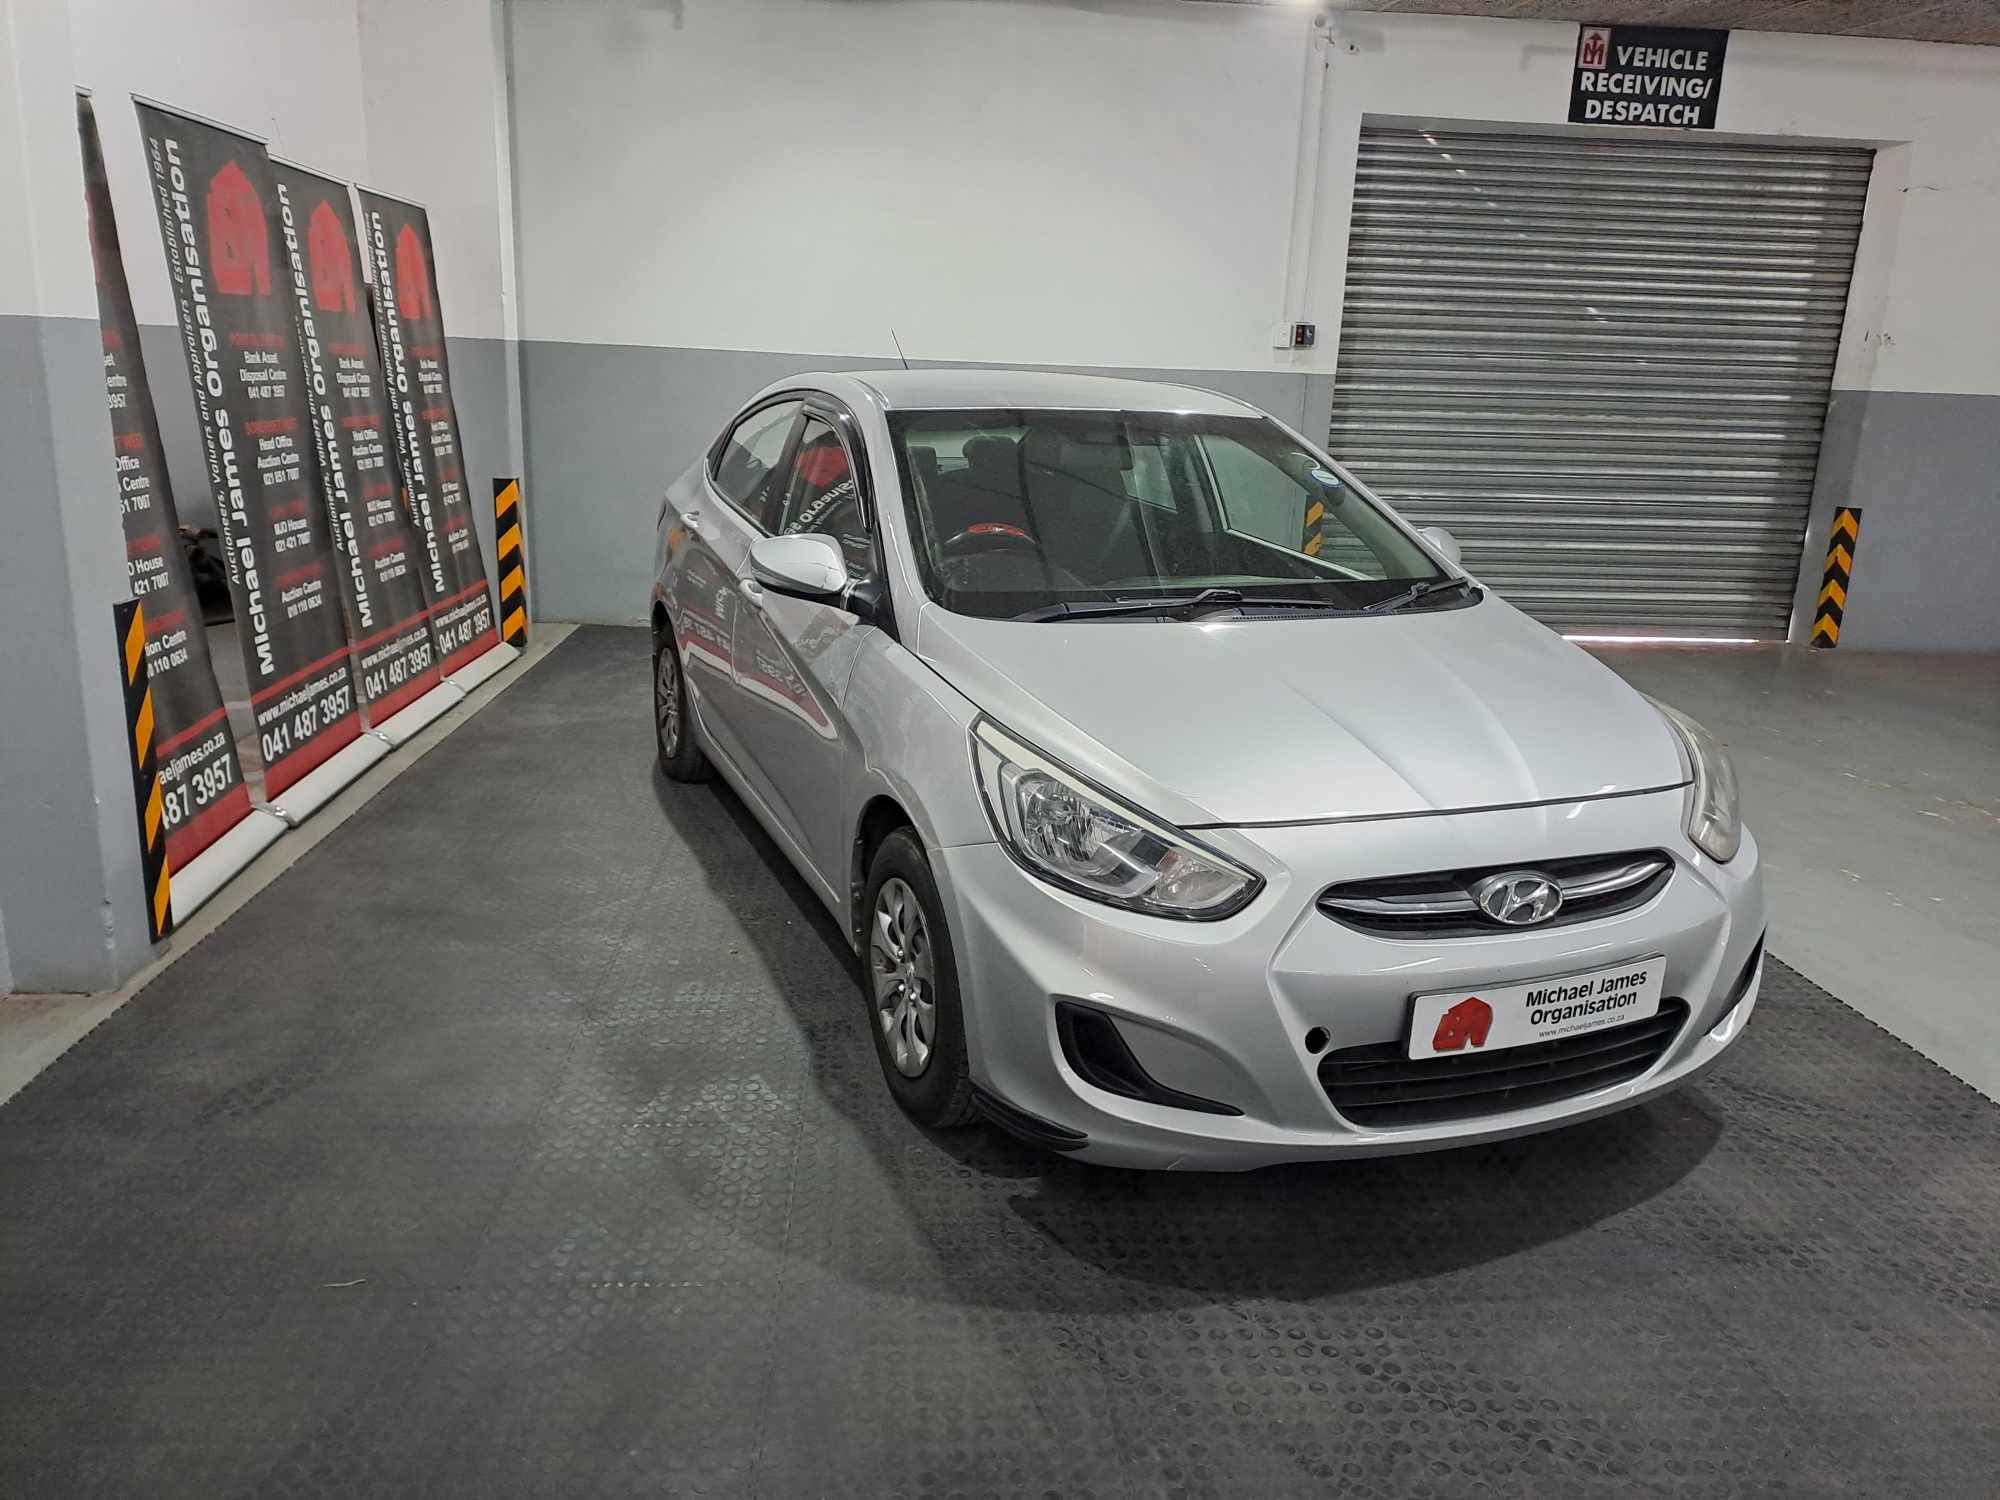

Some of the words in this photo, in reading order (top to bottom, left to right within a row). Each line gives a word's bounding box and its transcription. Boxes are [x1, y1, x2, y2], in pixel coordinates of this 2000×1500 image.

[1580, 71, 1713, 99] RECEIVING/
[1616, 45, 1709, 71] VEHICLE
[1584, 99, 1700, 125] DESPATCH
[165, 138, 223, 398] Organisation
[277, 183, 326, 396] Organisation
[371, 211, 408, 394] Organisation
[196, 388, 210, 422] and
[214, 408, 248, 528] James
[320, 405, 348, 503] James
[403, 401, 425, 486] James
[135, 556, 163, 573] House
[339, 512, 374, 628] Michael
[417, 493, 445, 593] Michael
[236, 536, 275, 676] Michael
[439, 627, 457, 655] 041
[458, 618, 472, 643] 487
[365, 668, 388, 699] 041
[389, 656, 408, 685] 487
[408, 643, 432, 674] 3957
[262, 722, 291, 762] 041
[294, 704, 317, 740] 487
[320, 685, 350, 724] 3957
[192, 753, 232, 805] 3957
[1525, 980, 1594, 1008] Michael
[1597, 970, 1647, 995] James
[1530, 991, 1637, 1025] Organisation
